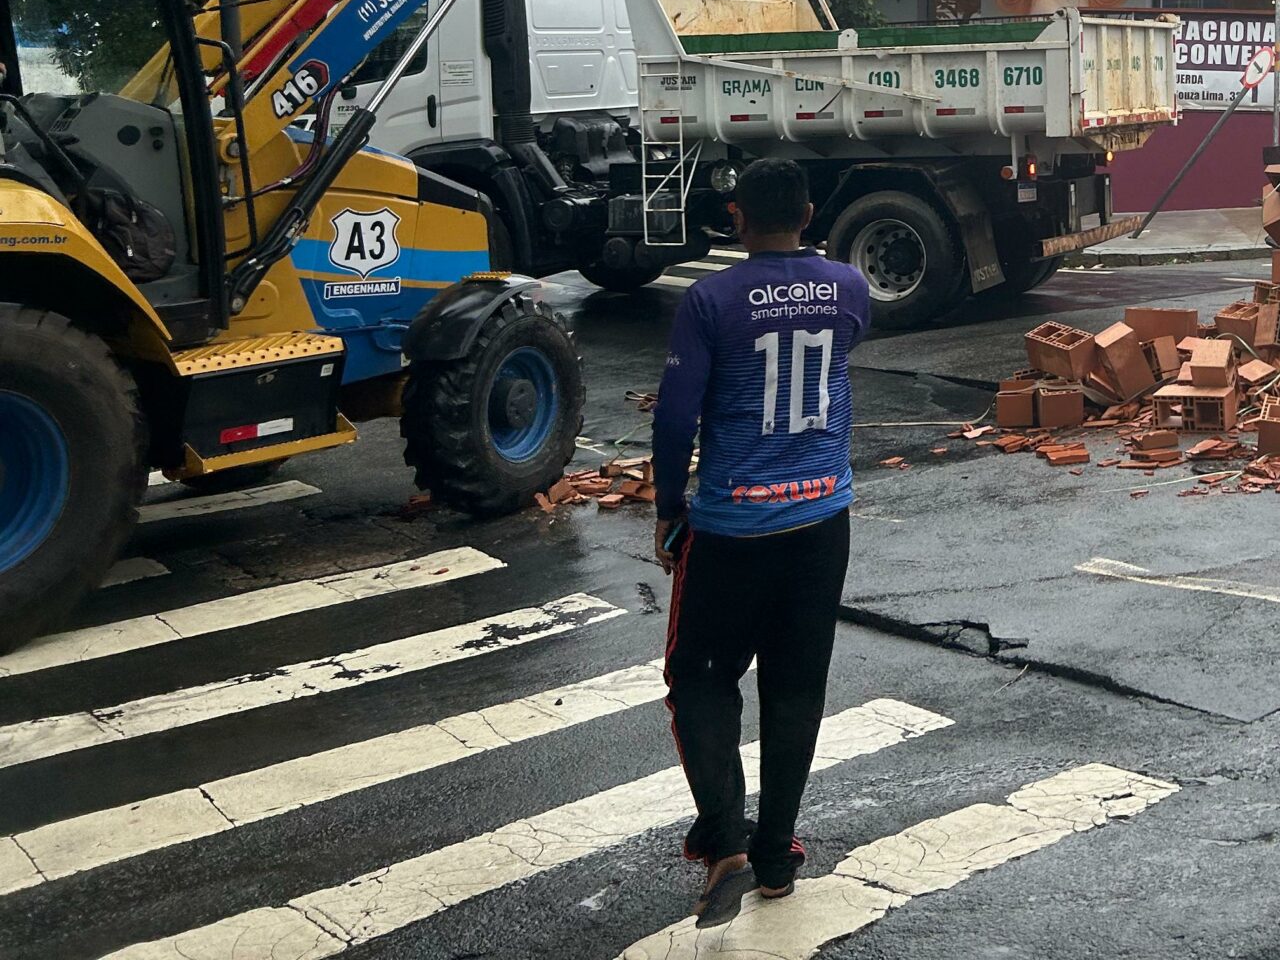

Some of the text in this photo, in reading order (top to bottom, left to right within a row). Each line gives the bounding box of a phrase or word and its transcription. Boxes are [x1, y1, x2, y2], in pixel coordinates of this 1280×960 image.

[358, 0, 378, 23] (11)
[660, 76, 697, 85] JUSARI
[723, 79, 771, 97] GRAMA
[868, 71, 900, 88] (19)
[935, 68, 980, 88] 3468
[1003, 66, 1043, 86] 6710
[272, 69, 319, 117] 416
[1177, 91, 1200, 101] ouza
[1202, 91, 1224, 101] Lima
[345, 221, 385, 260] A3
[333, 283, 397, 295] ENGENHARIA
[749, 281, 838, 306] alcatel
[751, 303, 838, 321] smartphones
[755, 329, 833, 436] 10
